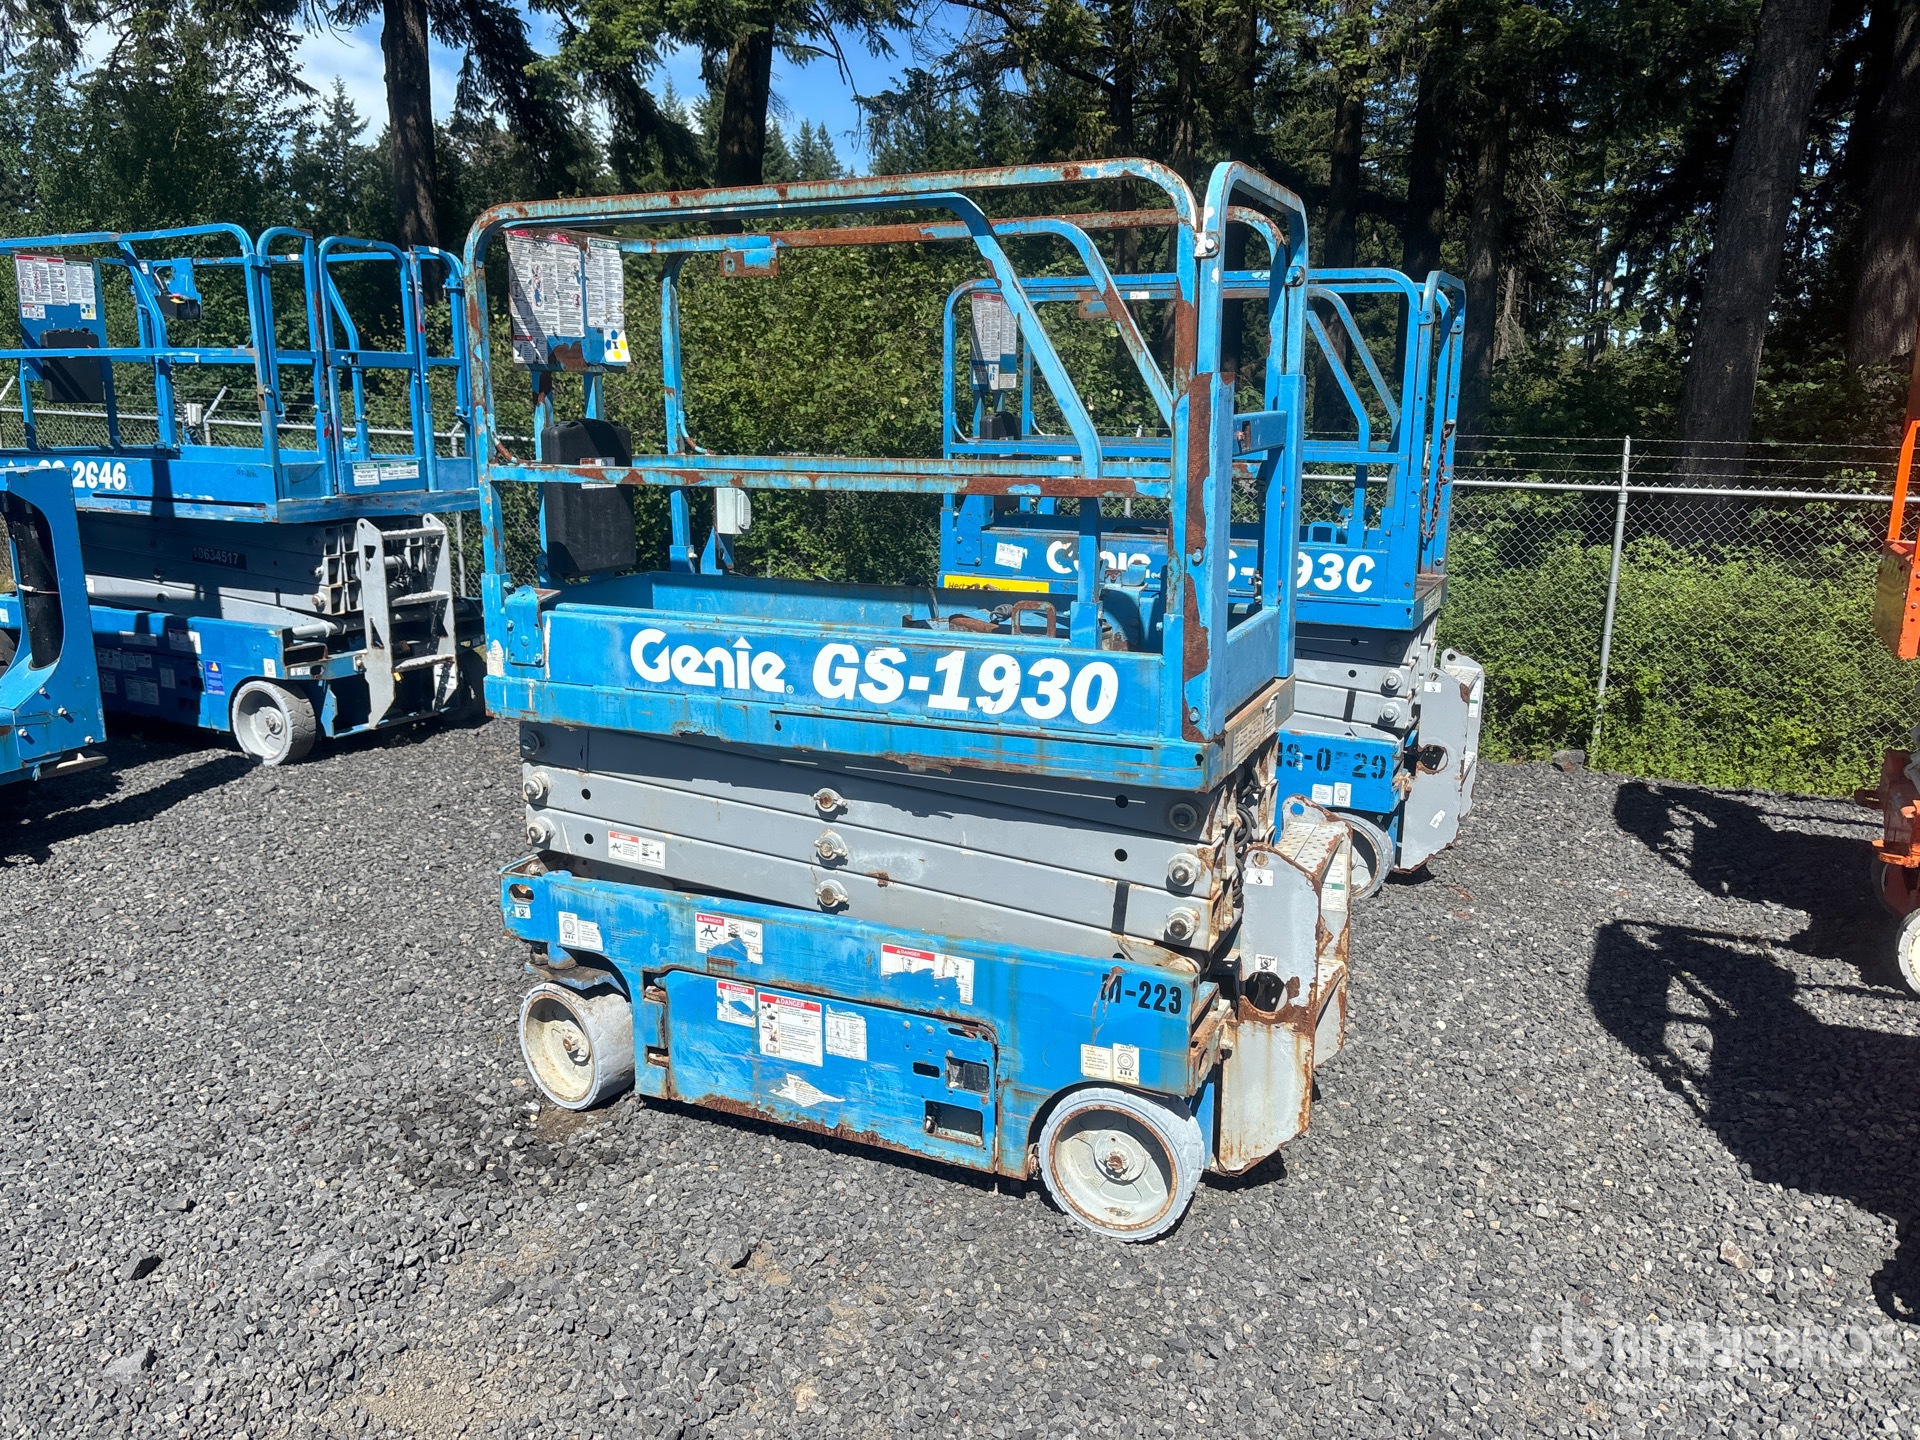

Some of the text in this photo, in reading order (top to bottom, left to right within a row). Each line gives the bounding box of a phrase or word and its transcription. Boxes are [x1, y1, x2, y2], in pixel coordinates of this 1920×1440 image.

[630, 628, 1119, 724] Genie GS-1930
[900, 949, 921, 958] DANGER
[730, 985, 749, 993] DANGER
[780, 998, 805, 1009] DANGER
